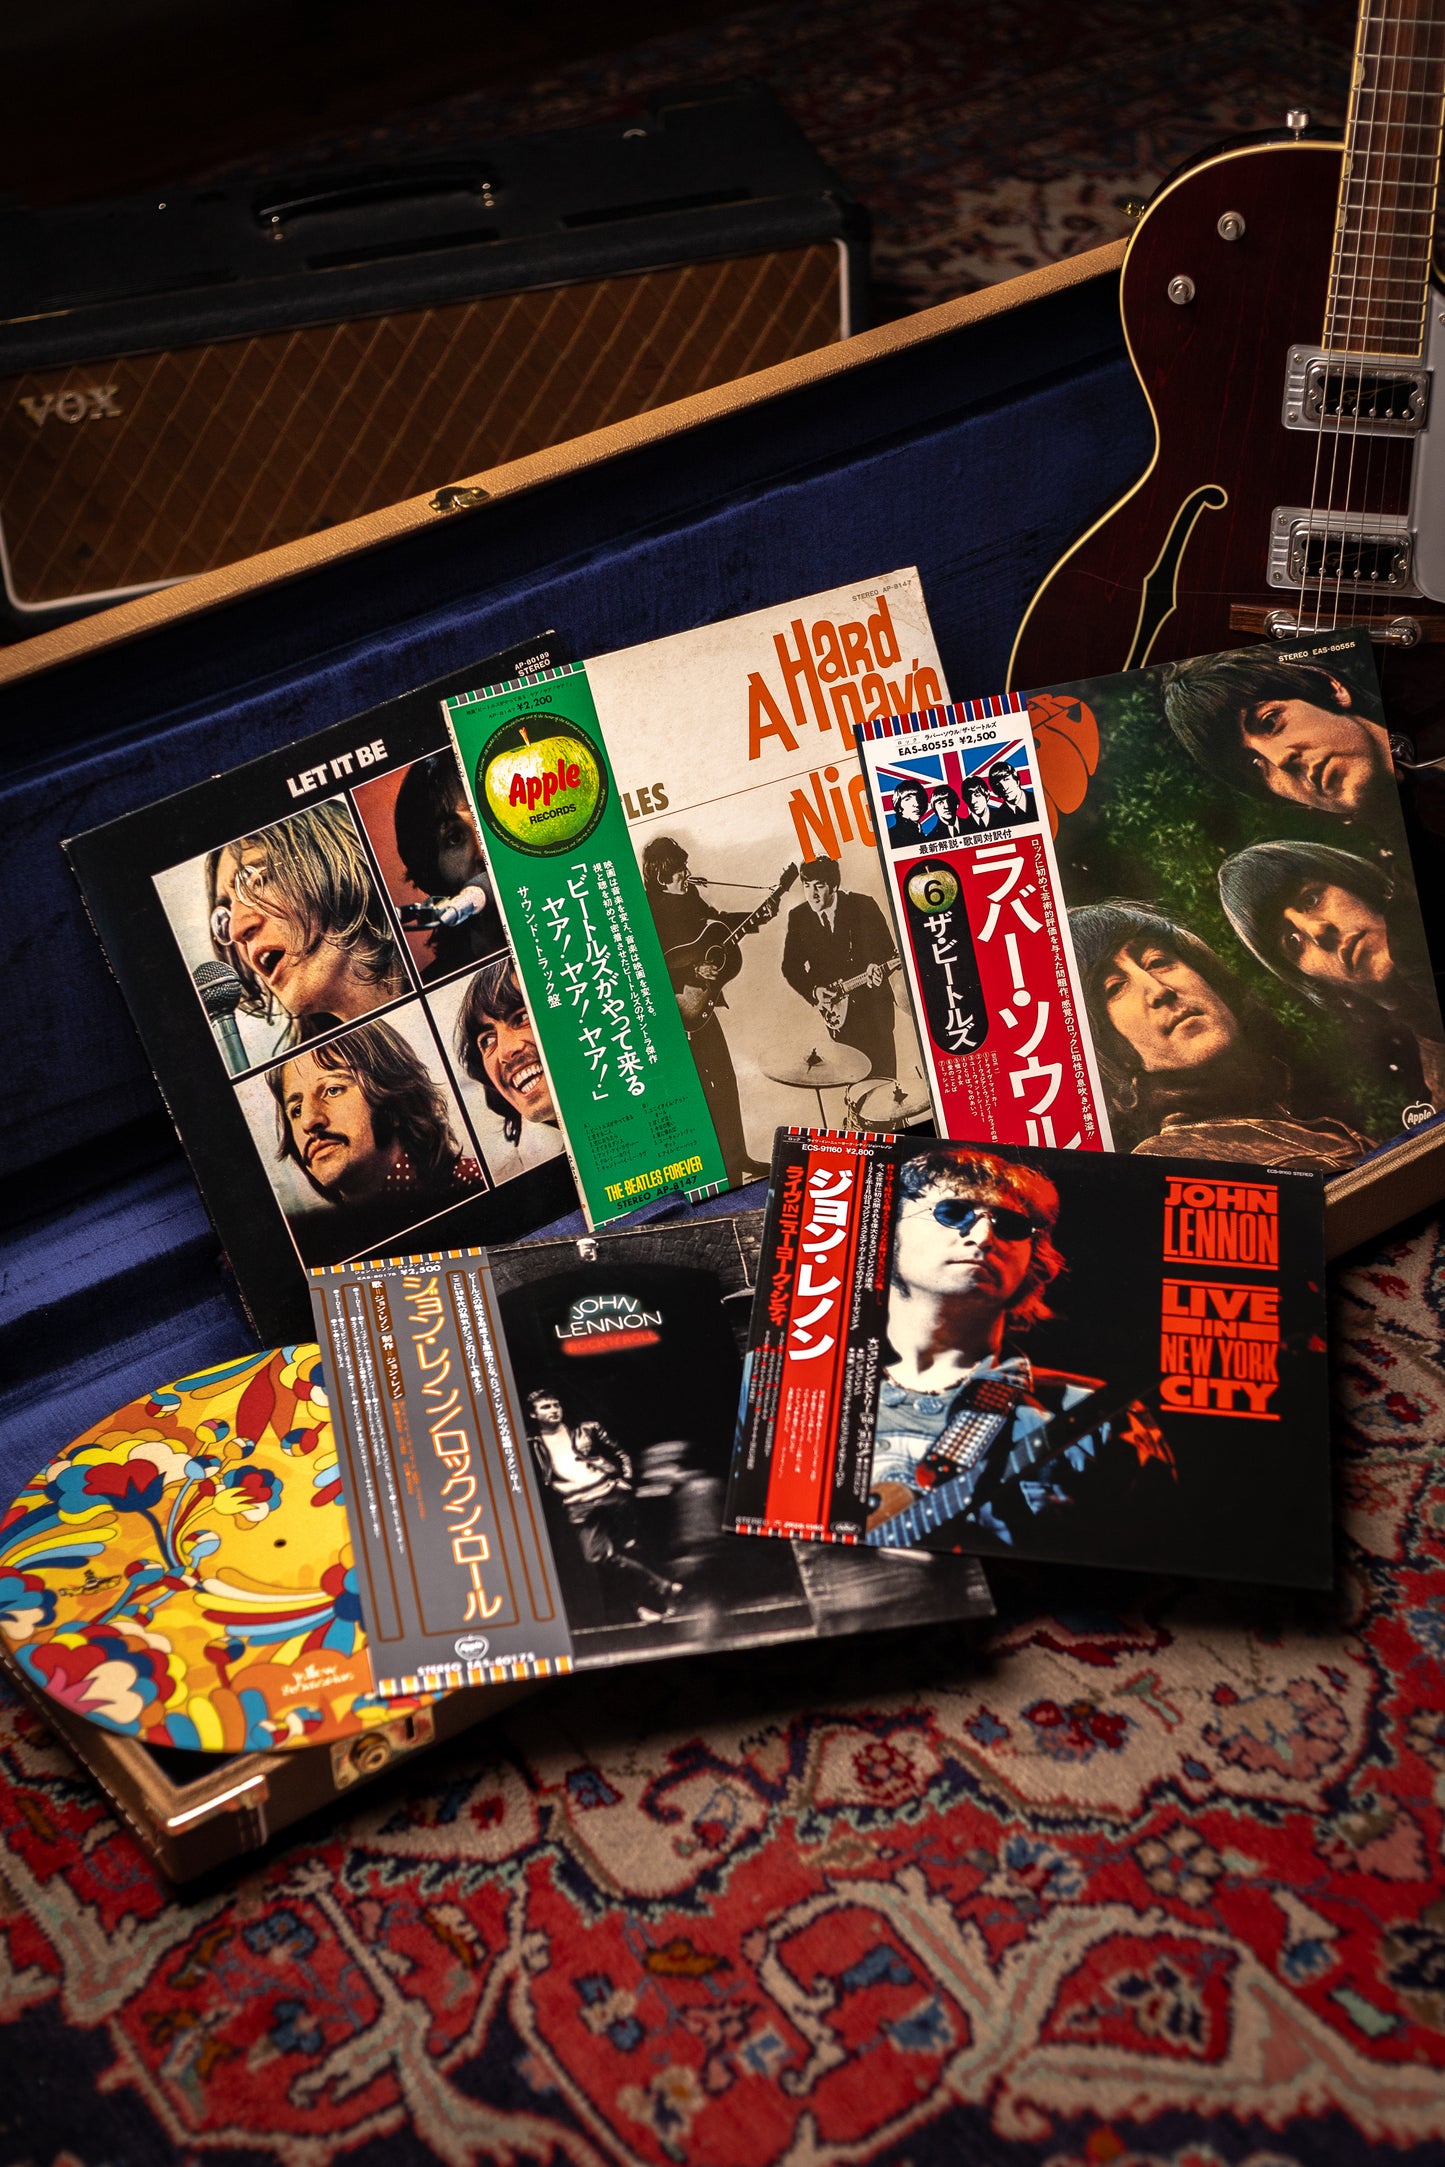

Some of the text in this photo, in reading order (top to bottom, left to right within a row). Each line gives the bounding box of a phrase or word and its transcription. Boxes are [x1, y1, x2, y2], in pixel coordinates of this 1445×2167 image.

[19, 385, 122, 427] VOX
[852, 589, 879, 602] STEREO
[1278, 641, 1356, 661] STEREO EAS-80555
[518, 659, 551, 677] STEREO
[516, 695, 553, 712] ¥2,200
[747, 671, 800, 761] A
[897, 729, 997, 757] EAS-80555 ¥2,500
[286, 739, 388, 798] LET IT BE
[508, 759, 581, 810] Apple
[529, 803, 577, 825] RECORDS
[921, 877, 946, 907] 6
[515, 885, 562, 1008] サウンド・トラック盤
[922, 910, 979, 1051] ザ・ビートルズ
[1408, 1110, 1431, 1125] Apple
[802, 1143, 874, 1155] ECS-91160 ¥2,800
[604, 1155, 704, 1201] THE BEATLES FOREVER
[615, 1175, 699, 1209] STEREO AP-8147
[1164, 1183, 1277, 1214] JOHN
[1163, 1206, 1278, 1263] LENNON
[400, 1265, 441, 1275] ¥2,500
[788, 1164, 856, 1365] ジョン・レノン
[572, 1296, 638, 1320] JOHN
[1161, 1284, 1279, 1323] LIVE
[554, 1310, 663, 1339] LENNON
[1203, 1319, 1237, 1338] IN
[1160, 1333, 1279, 1382] NEW YORK
[1159, 1375, 1279, 1412] CITY
[416, 1660, 462, 1676] STEREO
